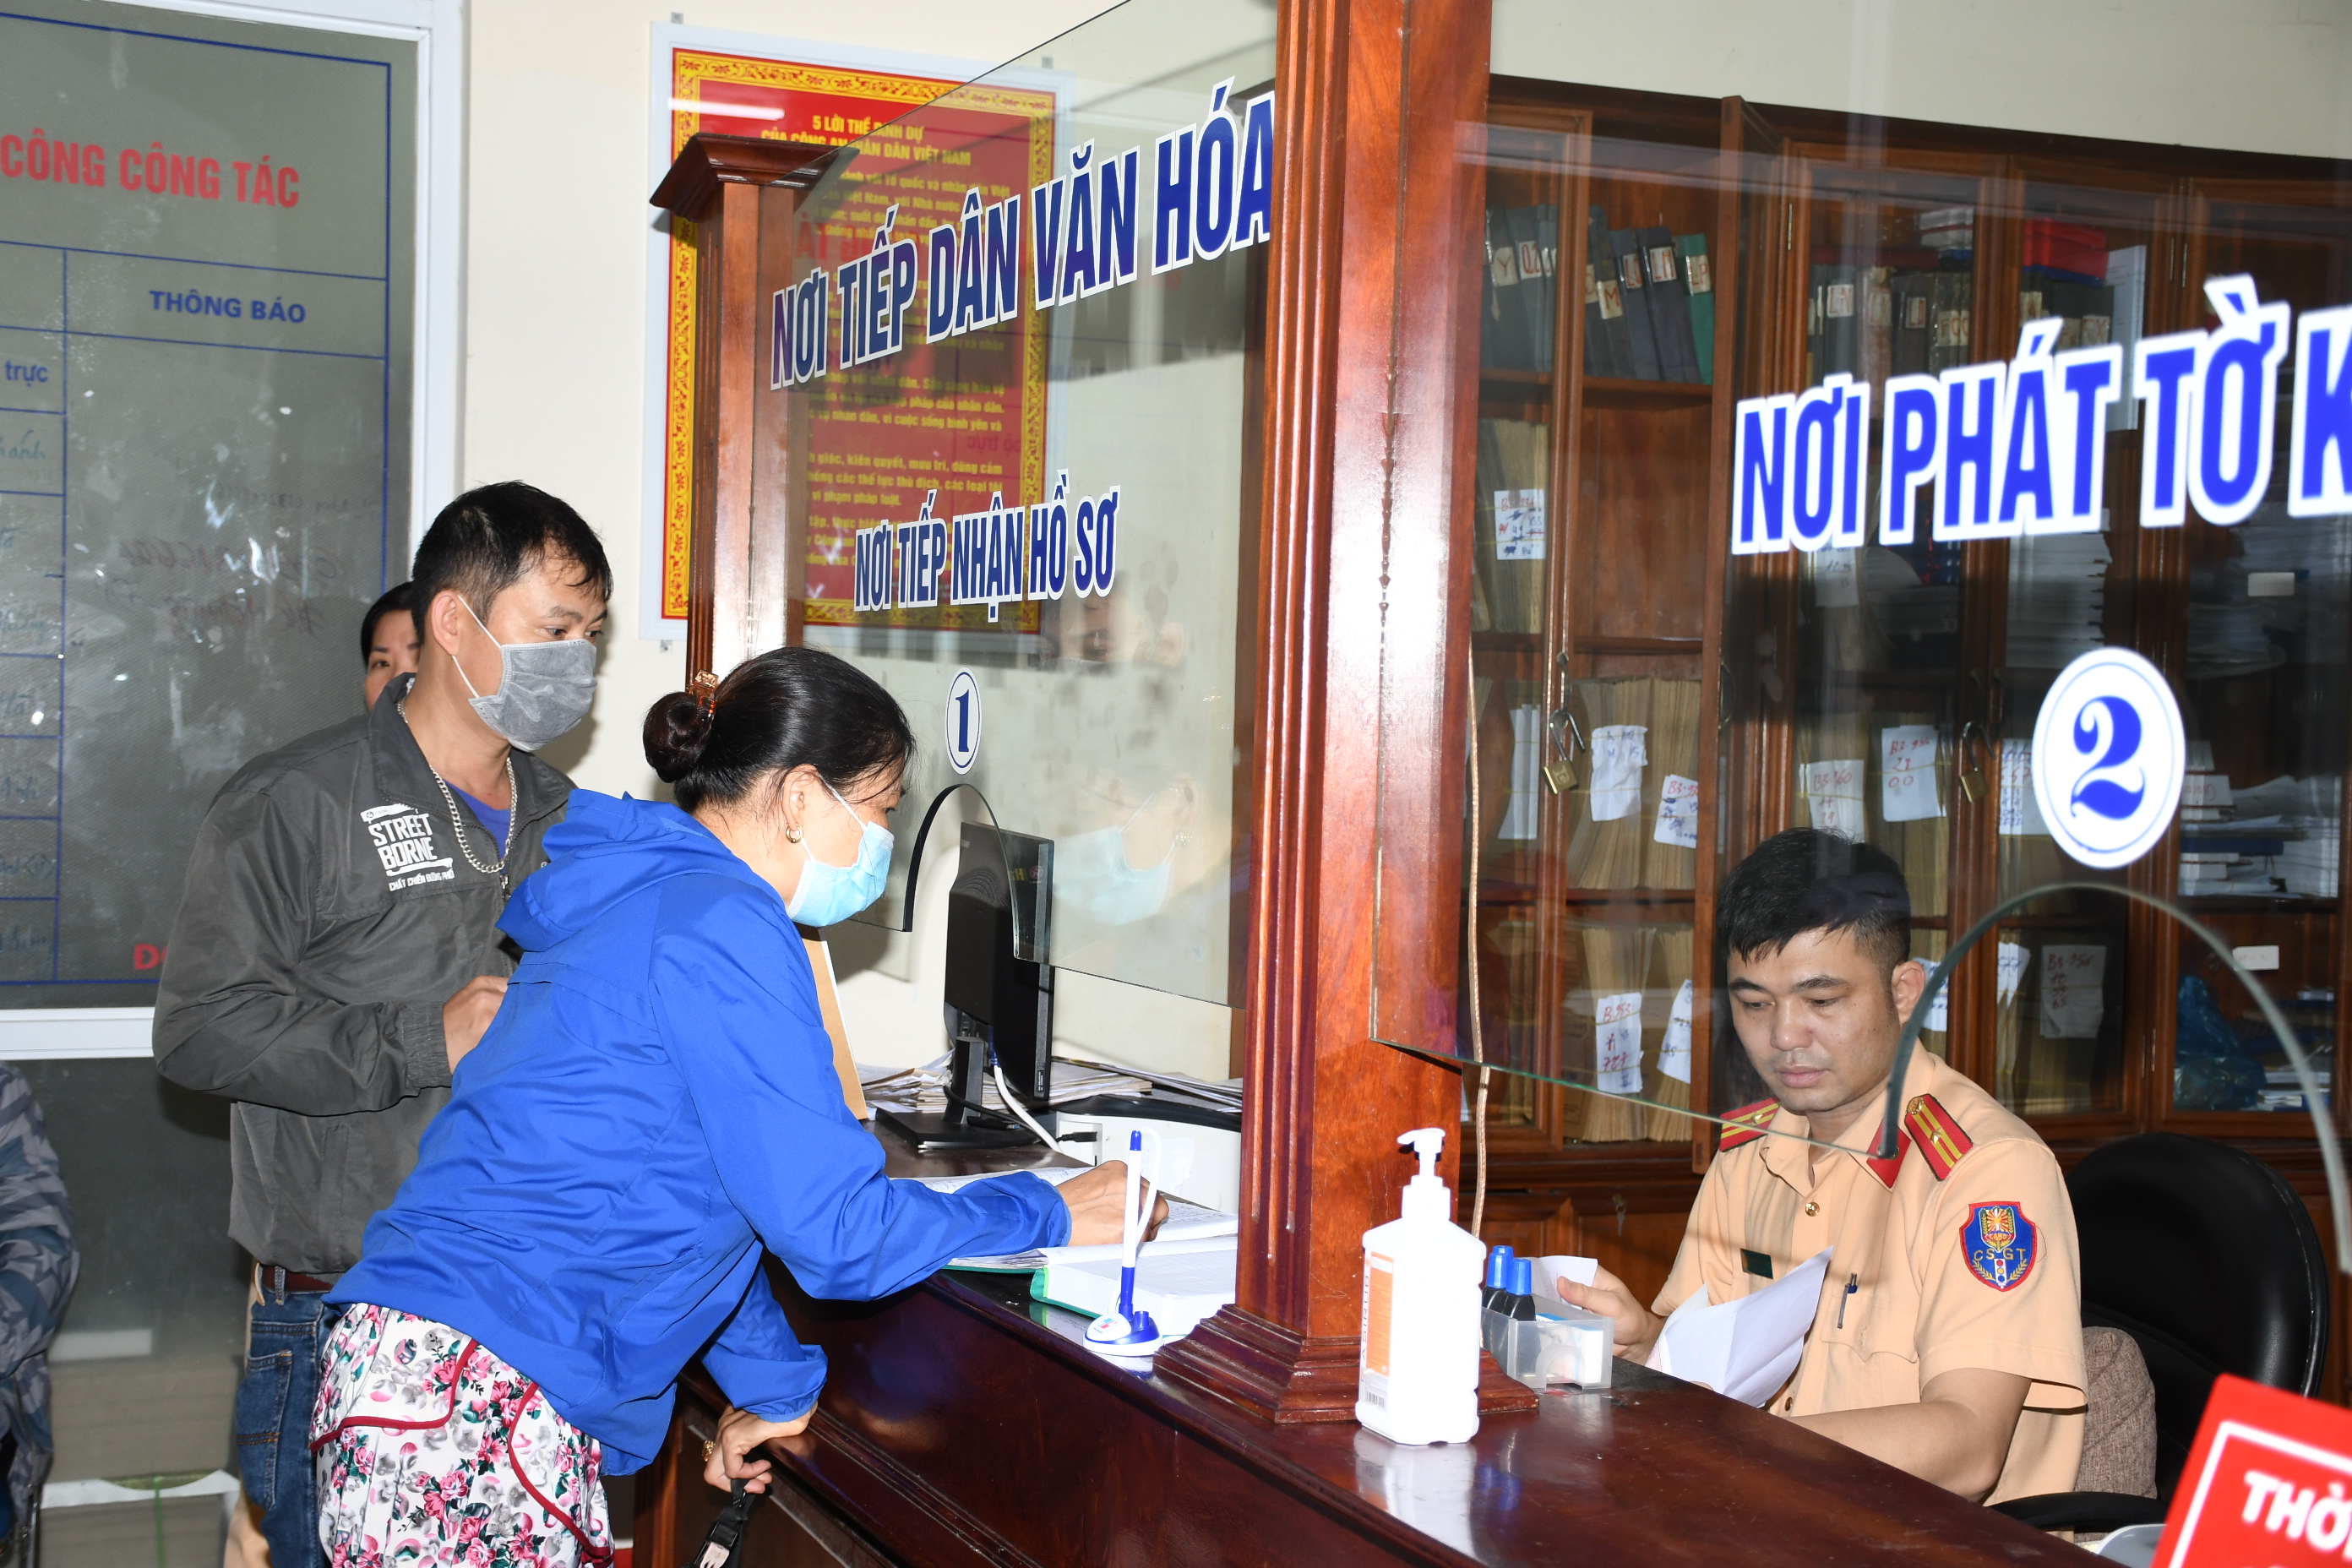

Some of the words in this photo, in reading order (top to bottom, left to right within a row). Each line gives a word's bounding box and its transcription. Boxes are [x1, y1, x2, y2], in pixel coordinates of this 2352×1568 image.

[812, 115, 822, 130] 5
[824, 113, 845, 133] LỜI
[0, 128, 106, 187] CÔNG
[118, 141, 221, 199] CÔNG
[232, 155, 300, 208] TÁC
[943, 150, 972, 166] NAM
[770, 267, 829, 391] NƠI
[837, 203, 918, 369] TIẾP
[926, 187, 1021, 345] DÂN
[1032, 138, 1140, 310] VĂN
[1152, 75, 1275, 275] HÓA
[150, 289, 242, 319] THÔNG
[252, 296, 306, 324] BÁO
[4, 359, 49, 387] trực
[1731, 373, 1870, 555] NƠI
[1878, 315, 2123, 546] PHÁT
[2134, 272, 2291, 528] TỜ
[854, 519, 893, 612] NƠI
[896, 489, 947, 608] TIẾP
[950, 490, 1025, 623] NHẬN
[1028, 468, 1070, 600] HỒ
[1073, 485, 1121, 598] SƠ
[955, 689, 970, 753] 1
[2070, 694, 2146, 821] 2
[368, 813, 433, 847] STREET
[378, 837, 438, 870] BORNE
